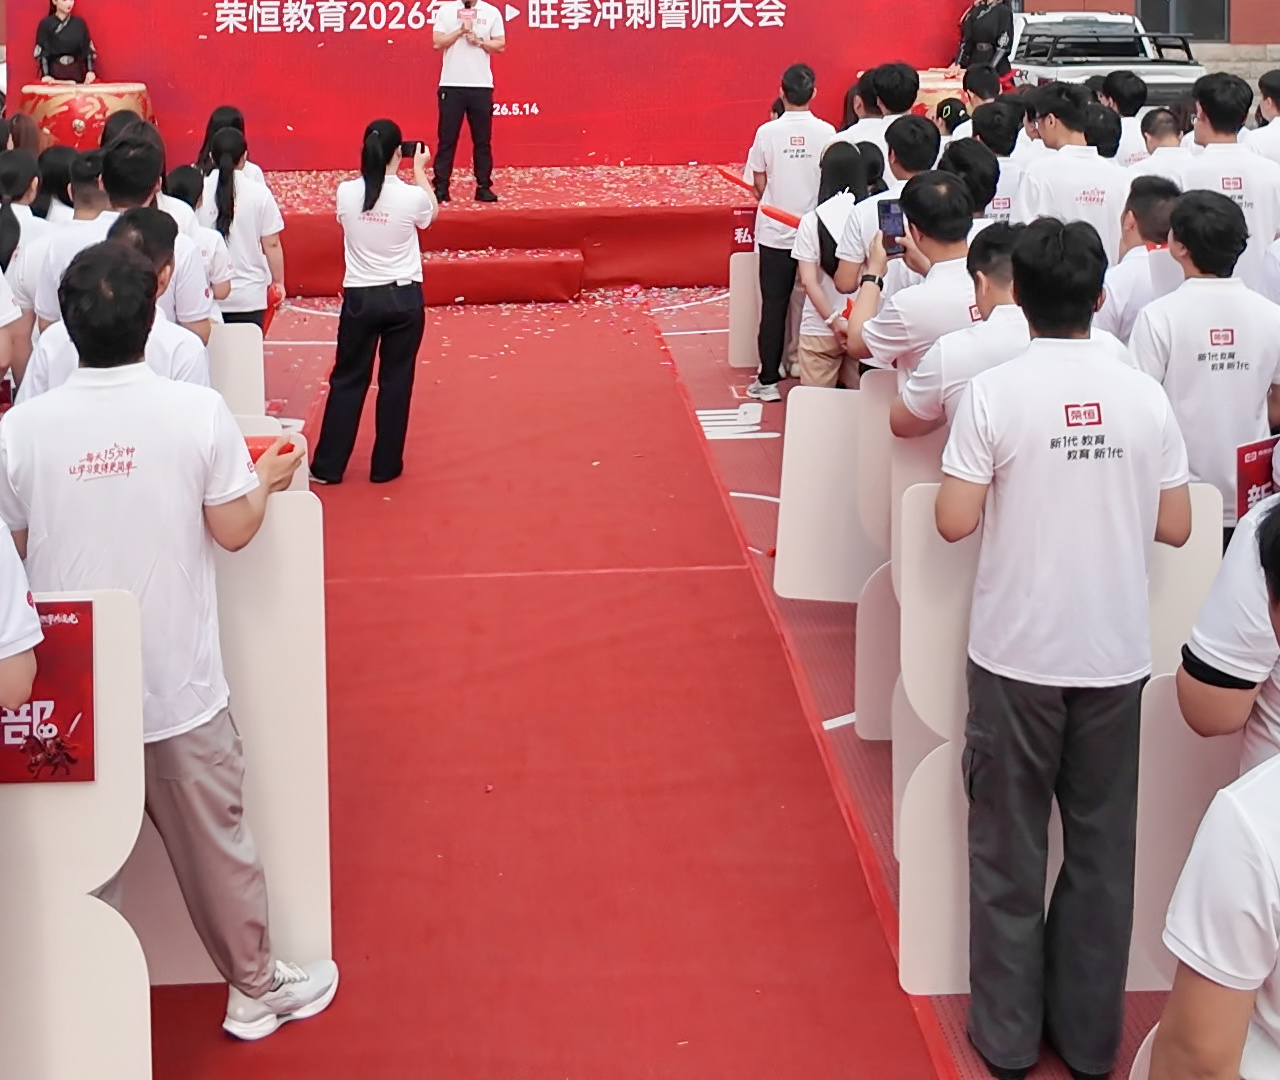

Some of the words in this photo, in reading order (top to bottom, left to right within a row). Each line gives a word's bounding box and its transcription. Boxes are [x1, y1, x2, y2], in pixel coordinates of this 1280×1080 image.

[734, 226, 756, 245] 私
[1049, 435, 1078, 449] 新1代
[1094, 447, 1124, 459] 新1代
